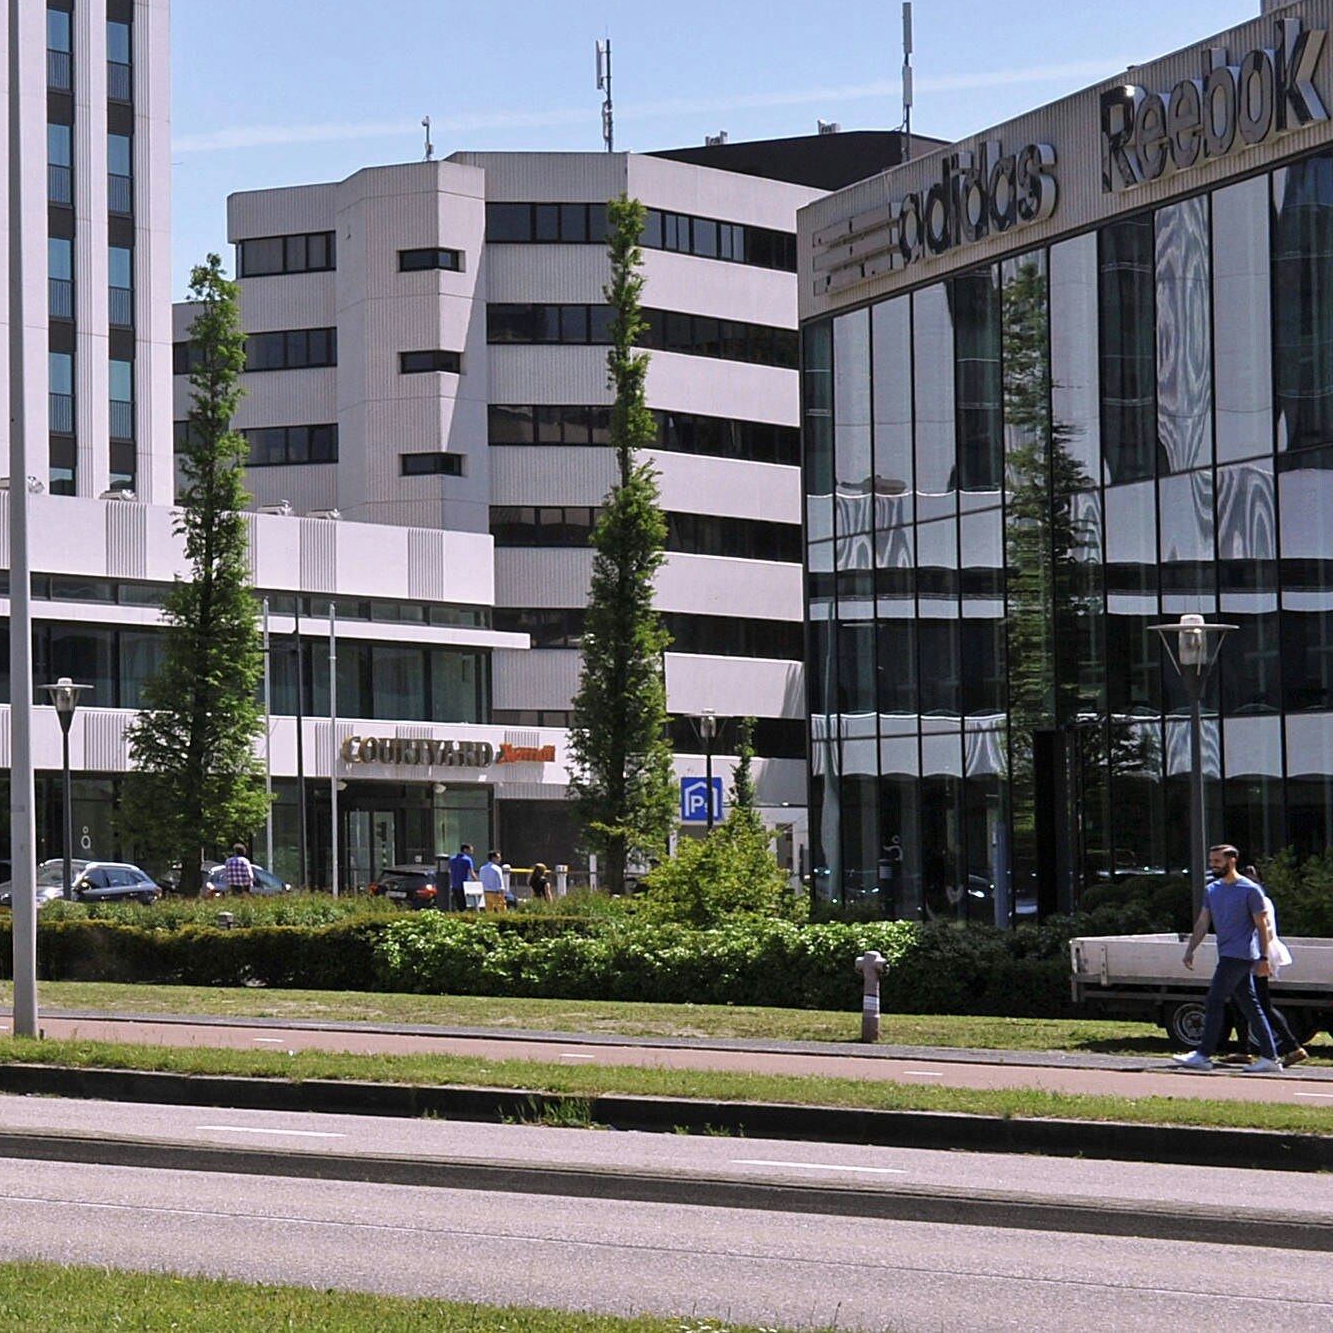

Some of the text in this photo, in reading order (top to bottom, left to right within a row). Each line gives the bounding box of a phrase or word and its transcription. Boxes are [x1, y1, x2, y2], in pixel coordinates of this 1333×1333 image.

[1100, 18, 1331, 194] Reebok
[899, 140, 1059, 264] adidas
[340, 736, 494, 768] COURTYARD
